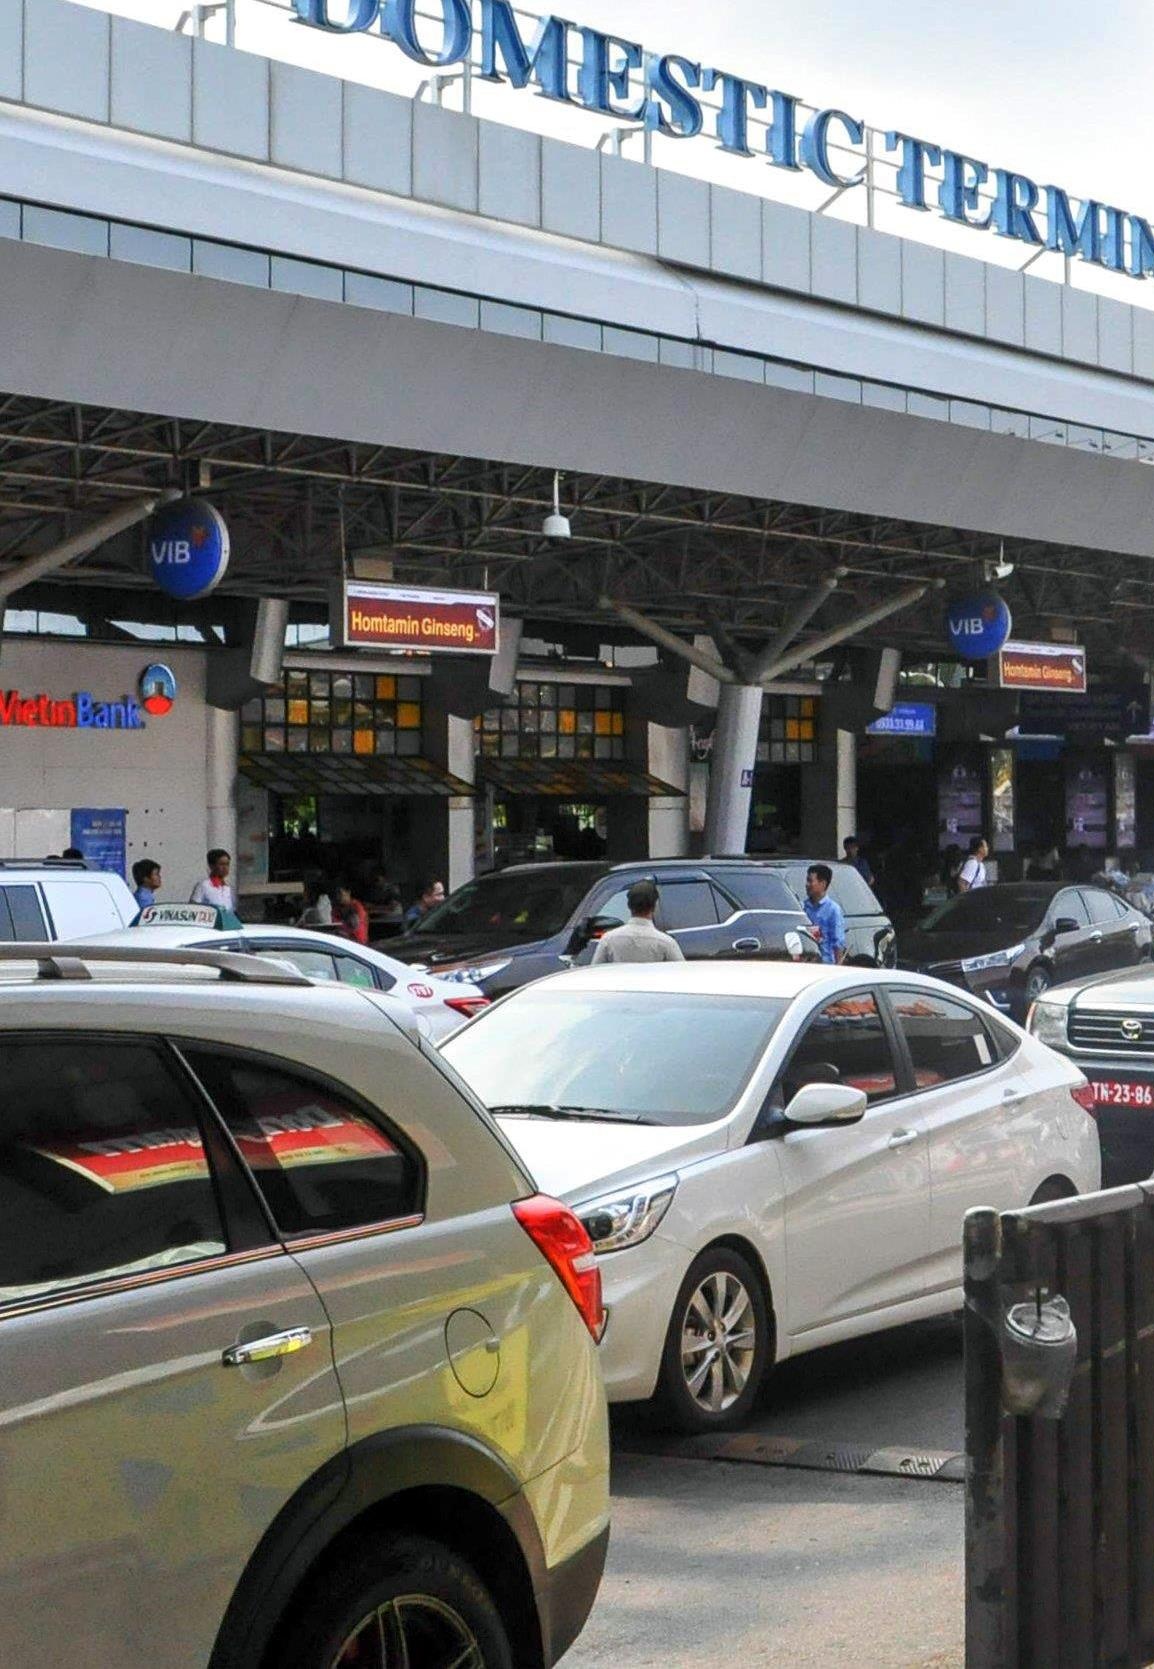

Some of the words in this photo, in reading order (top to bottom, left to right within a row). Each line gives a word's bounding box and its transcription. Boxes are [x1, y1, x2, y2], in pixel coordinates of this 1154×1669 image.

[152, 540, 191, 565] VIB
[351, 610, 420, 636] Homtamin
[421, 617, 475, 642] Ginseng
[950, 618, 984, 636] VIB
[0, 690, 144, 730] VietinBank
[159, 909, 198, 922] VINASUN
